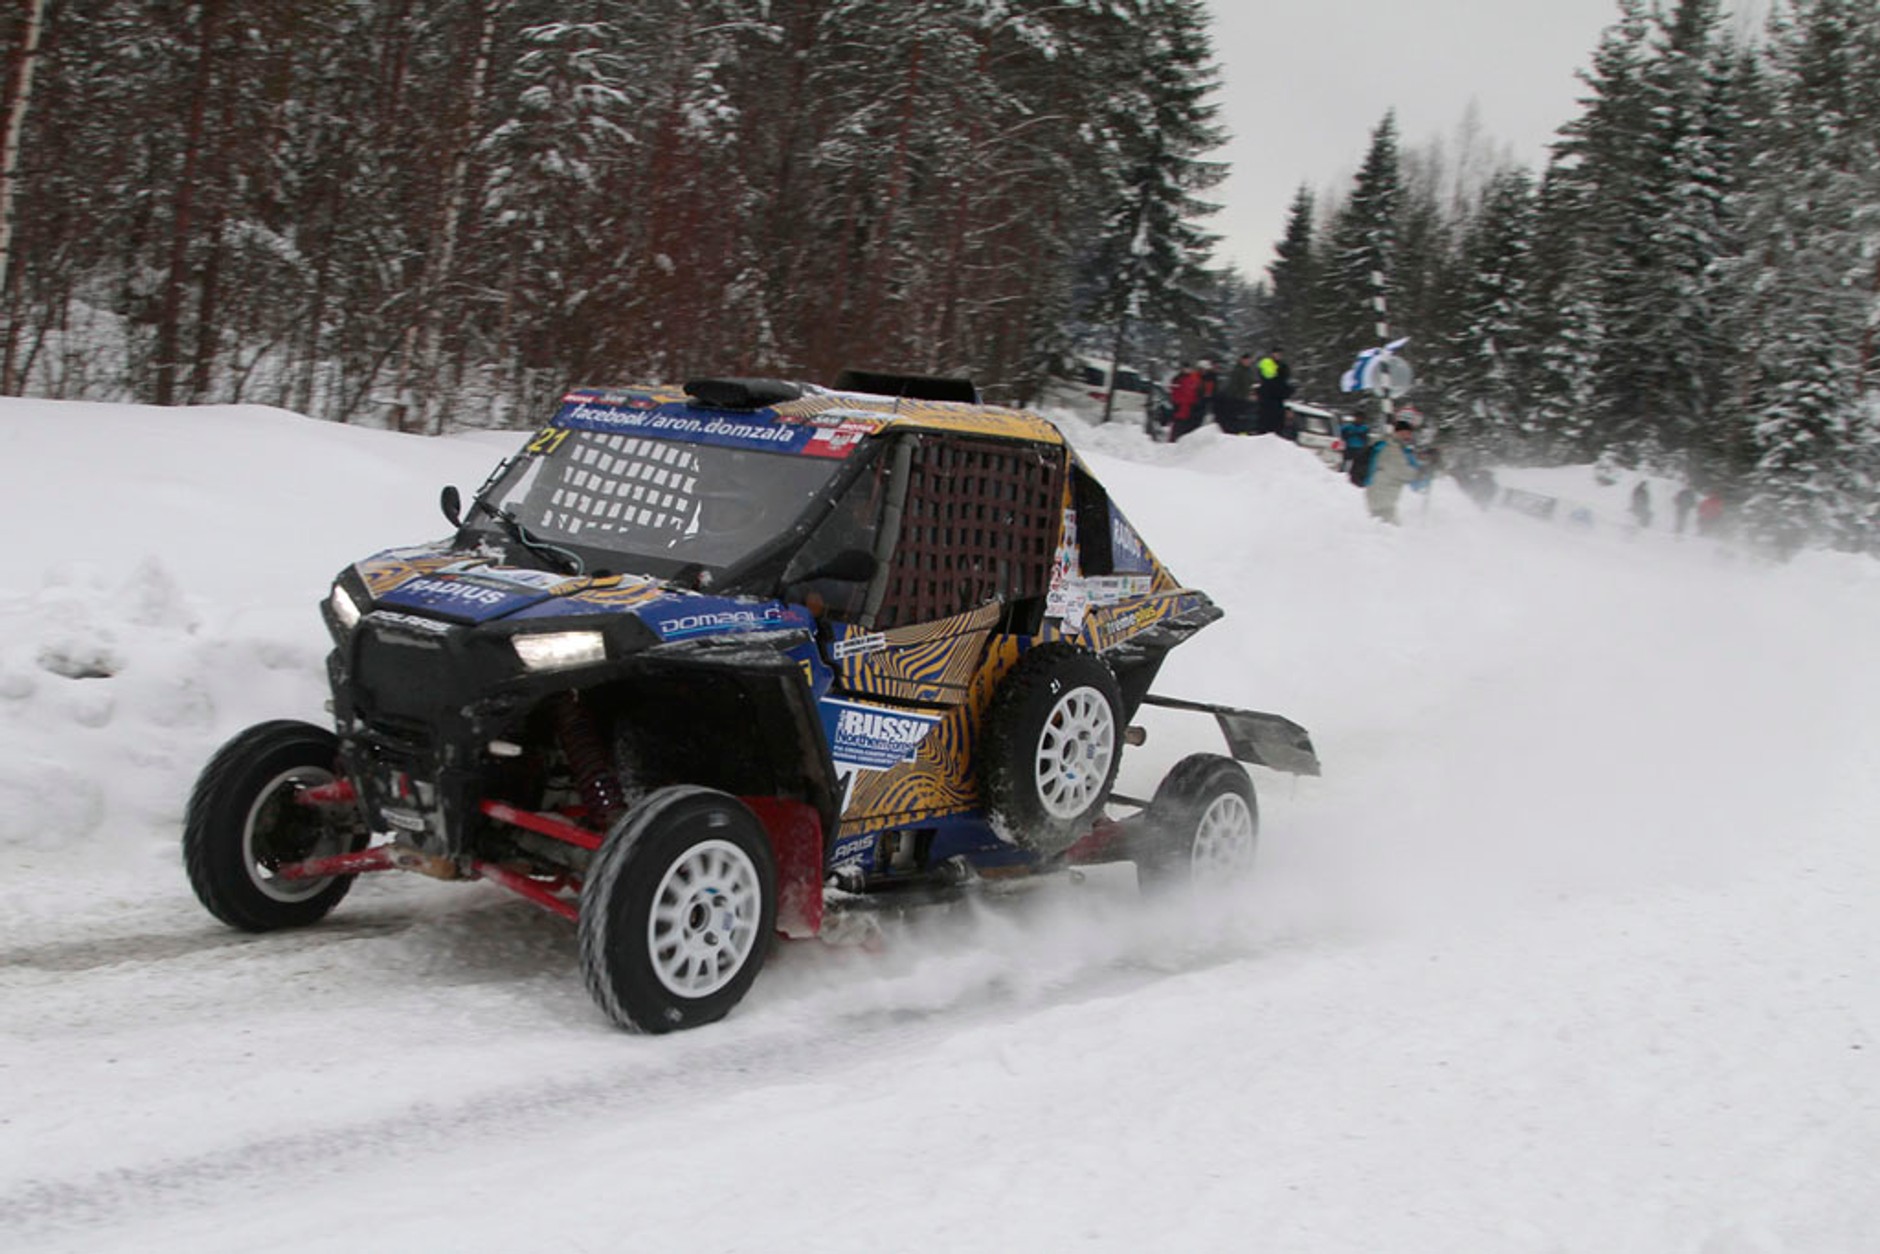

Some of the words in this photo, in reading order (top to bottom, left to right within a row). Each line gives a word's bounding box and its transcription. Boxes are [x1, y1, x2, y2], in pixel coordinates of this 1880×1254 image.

[570, 403, 795, 442] facebook/aron.domzala
[527, 427, 571, 454] 21
[401, 578, 506, 604] RADIUS
[366, 609, 452, 632] POLARIS
